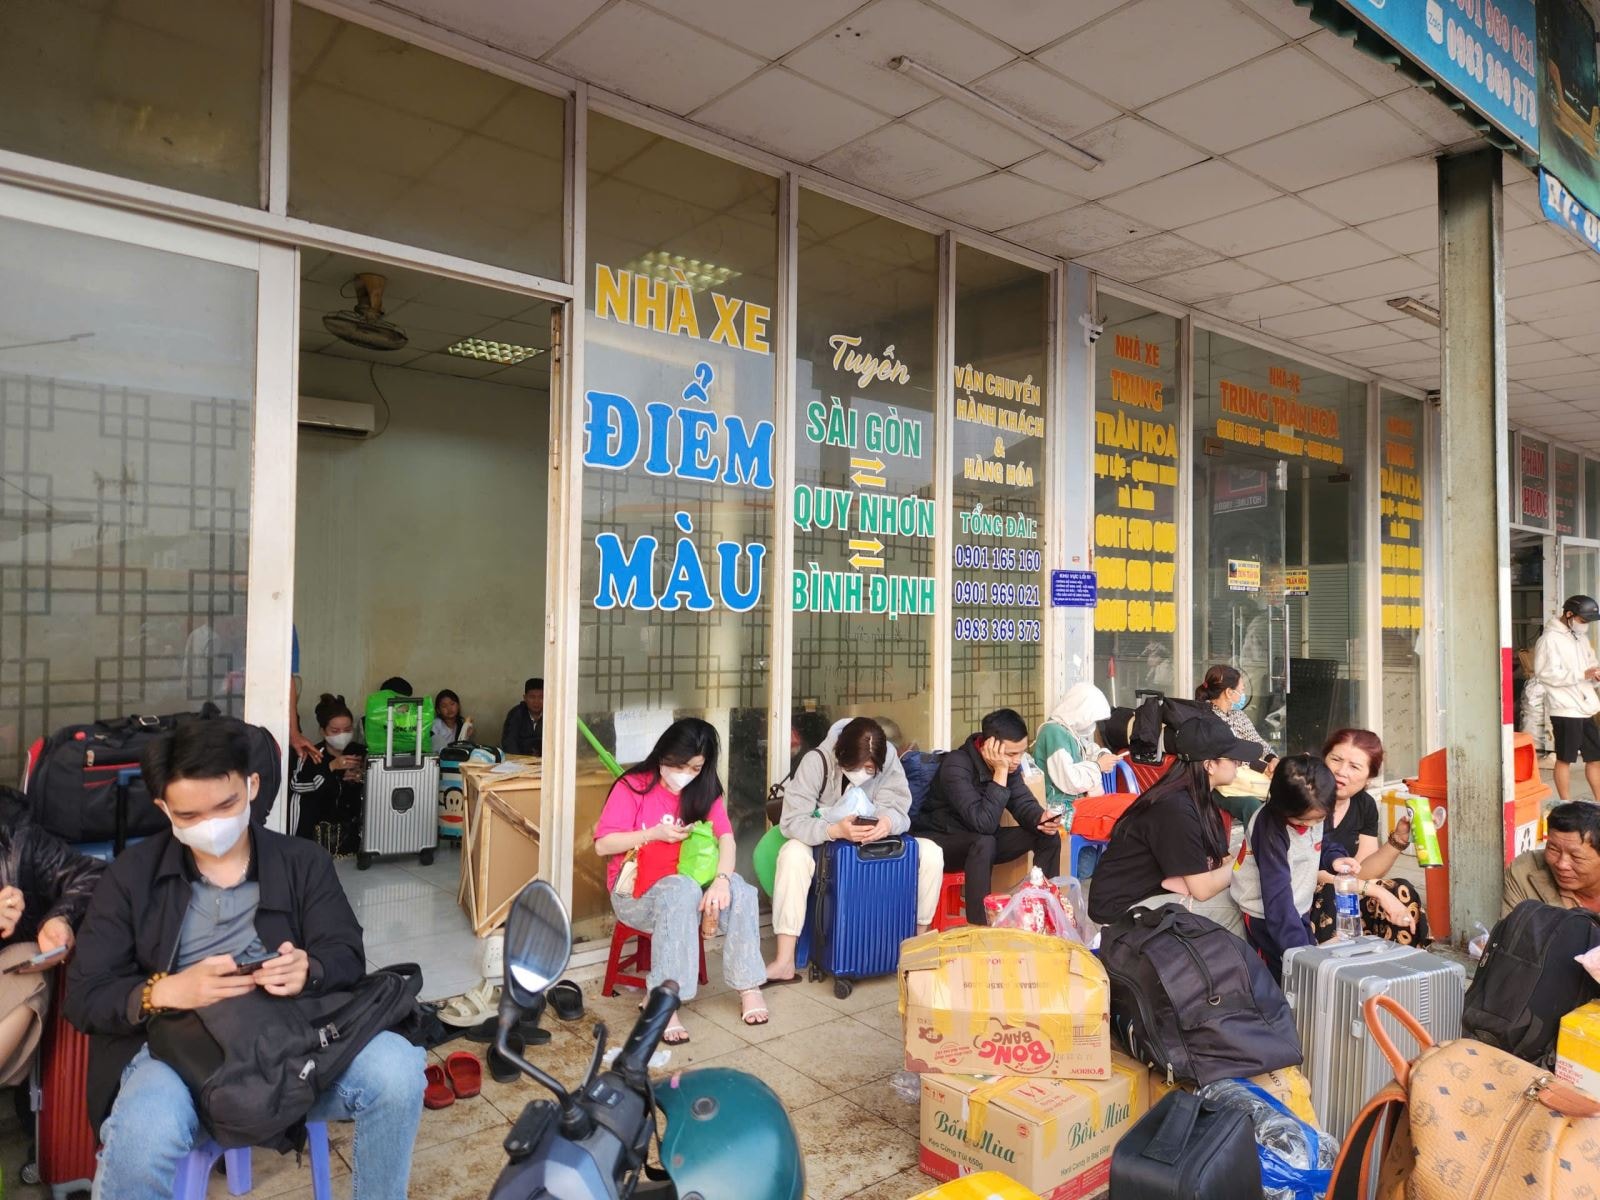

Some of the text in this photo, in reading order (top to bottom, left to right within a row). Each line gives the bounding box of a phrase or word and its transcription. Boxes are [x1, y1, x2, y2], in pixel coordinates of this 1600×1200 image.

[1447, 18, 1484, 84] 0983
[1513, 77, 1537, 128] 373
[1511, 25, 1535, 78] 021
[594, 262, 772, 356] NHÀ XE
[829, 334, 911, 389] Tuyến
[1144, 342, 1160, 368] XE
[954, 364, 1041, 407] VẬN CHUYỂN
[1110, 368, 1163, 412] TRUNG
[1219, 379, 1269, 422] TRUNG
[583, 361, 775, 489] ĐIỂM
[806, 396, 922, 459] SÀI GÒN
[956, 395, 1045, 438] HÀNH KHÁCH
[994, 436, 1006, 459] &
[964, 453, 1034, 487] HÀNG HÓA
[793, 484, 936, 538] QUY NHƠN
[960, 503, 1037, 539] TỔNG ĐÀI:
[593, 511, 767, 613] MÀU
[954, 544, 1041, 572] 0901 165 160
[792, 561, 937, 620] BÌNH ĐỊNH
[954, 580, 988, 604] 0901
[991, 582, 1016, 606] 969
[1017, 584, 1041, 607] 021
[954, 617, 1041, 642] 0983 369 373
[992, 1031, 1033, 1046] BANG
[1071, 1068, 1097, 1076] ORION
[934, 1110, 1016, 1164] Bốn Mùa
[1067, 1117, 1096, 1151] Bốn
[1101, 1102, 1130, 1133] Mùa
